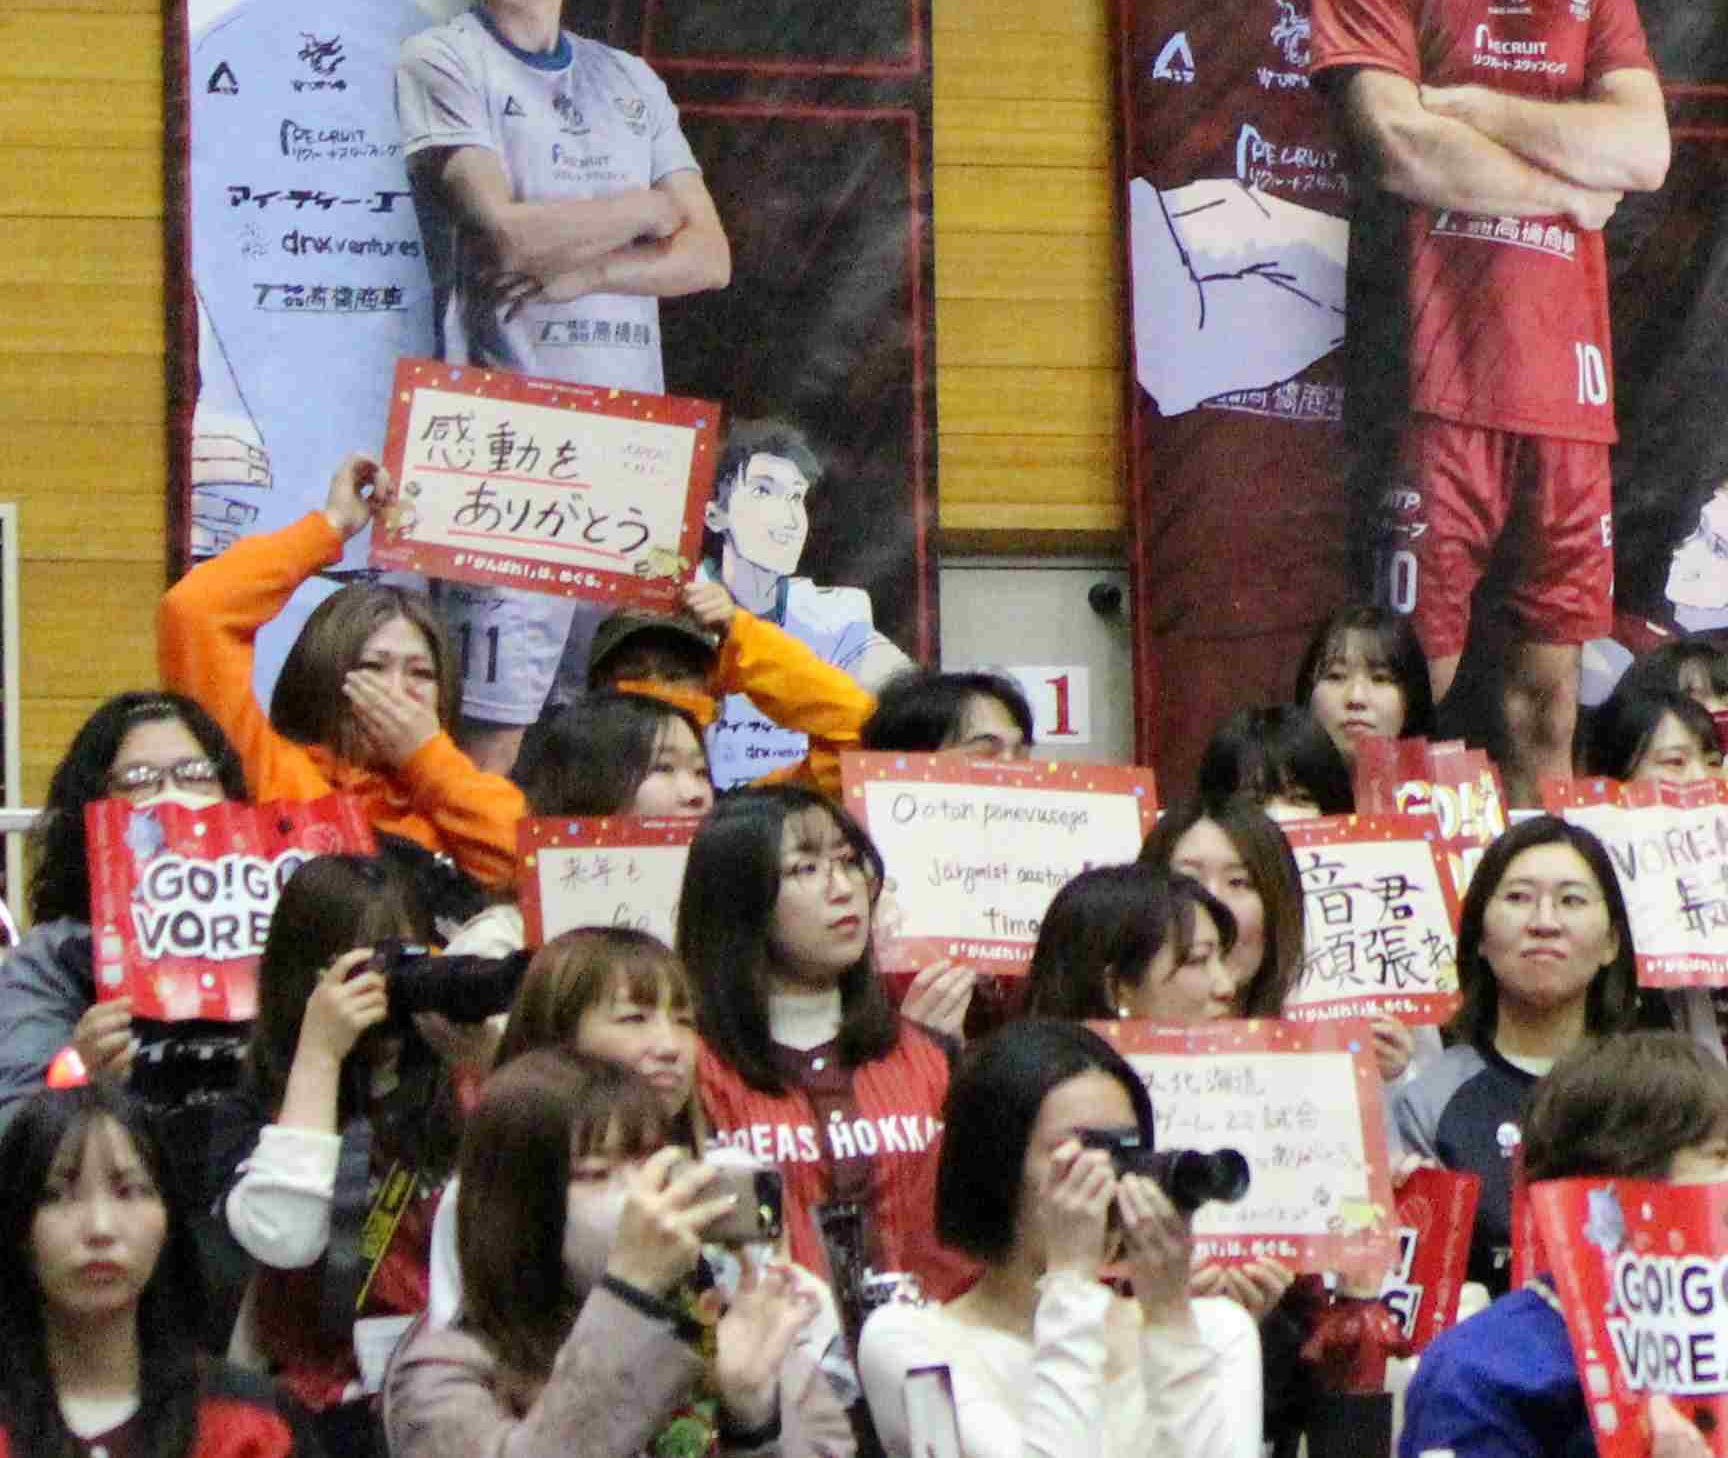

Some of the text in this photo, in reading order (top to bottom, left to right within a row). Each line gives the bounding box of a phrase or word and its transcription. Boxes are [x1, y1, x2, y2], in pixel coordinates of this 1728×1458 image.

[1575, 342, 1608, 406] 10
[421, 414, 580, 481] 感動を
[454, 481, 649, 554] ありがとう
[1045, 675, 1078, 735] 1
